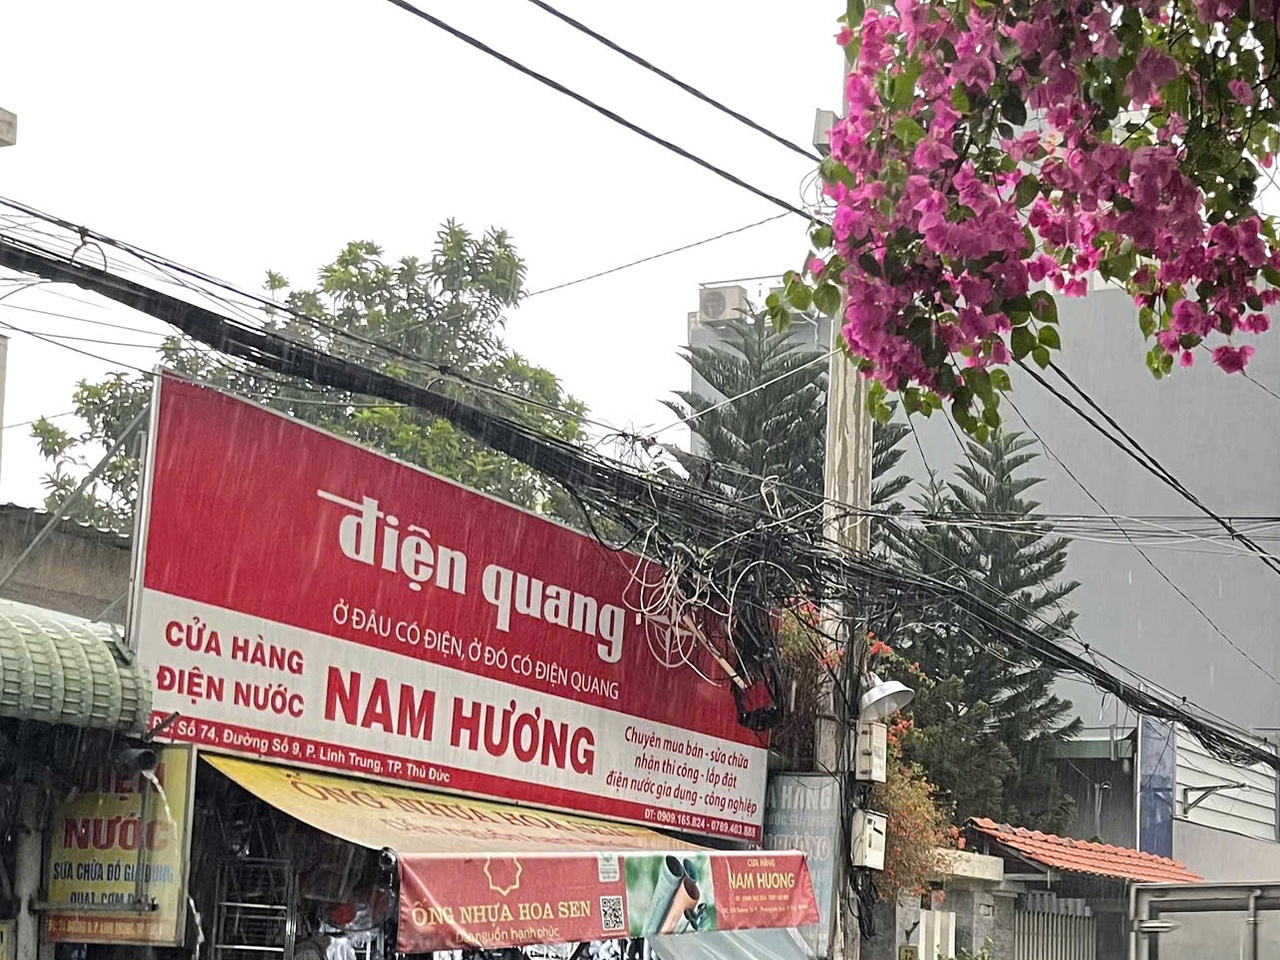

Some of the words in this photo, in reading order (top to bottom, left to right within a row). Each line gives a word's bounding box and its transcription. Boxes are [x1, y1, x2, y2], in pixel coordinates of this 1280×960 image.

[317, 489, 468, 595] điện
[482, 563, 626, 663] quang
[165, 616, 222, 657] CỬA
[231, 634, 304, 675] HÀNG
[333, 598, 349, 625] Ở
[352, 608, 392, 637] ĐÂU
[395, 621, 421, 645] CÓ
[423, 628, 465, 661] ĐIỆN,
[468, 637, 482, 662] Ở
[484, 646, 508, 669] ĐÓ
[511, 654, 532, 676] CÓ
[535, 661, 569, 687] ĐIỆN
[570, 671, 619, 699] QUANG
[156, 665, 225, 705] ĐIỆN
[233, 680, 304, 718] NƯỚC
[324, 665, 436, 742] NAM
[450, 699, 596, 775] HƯƠNG
[177, 720, 196, 737] Số
[200, 725, 219, 742] 74,
[223, 729, 269, 752] Đường
[272, 737, 289, 753] Số
[306, 744, 316, 759] P.
[320, 747, 345, 764] Linh
[349, 752, 384, 773] Trung,
[387, 760, 403, 774] TP.
[625, 725, 661, 750] Chuyên
[663, 740, 684, 754] mua
[686, 741, 704, 759] bán
[711, 747, 726, 764] sửa
[727, 753, 749, 769] chữa
[634, 753, 660, 774] nhận
[662, 759, 675, 774] thi
[676, 763, 699, 784] công
[606, 770, 628, 792] điện
[630, 776, 655, 793] nước
[656, 781, 671, 799] gia
[704, 792, 726, 811] công
[729, 872, 755, 890] NAM
[459, 903, 514, 927] NHỰA
[518, 902, 554, 920] HOA
[558, 900, 591, 918] SEN
[510, 927, 537, 942] hạnh
[537, 925, 560, 939] phúc
